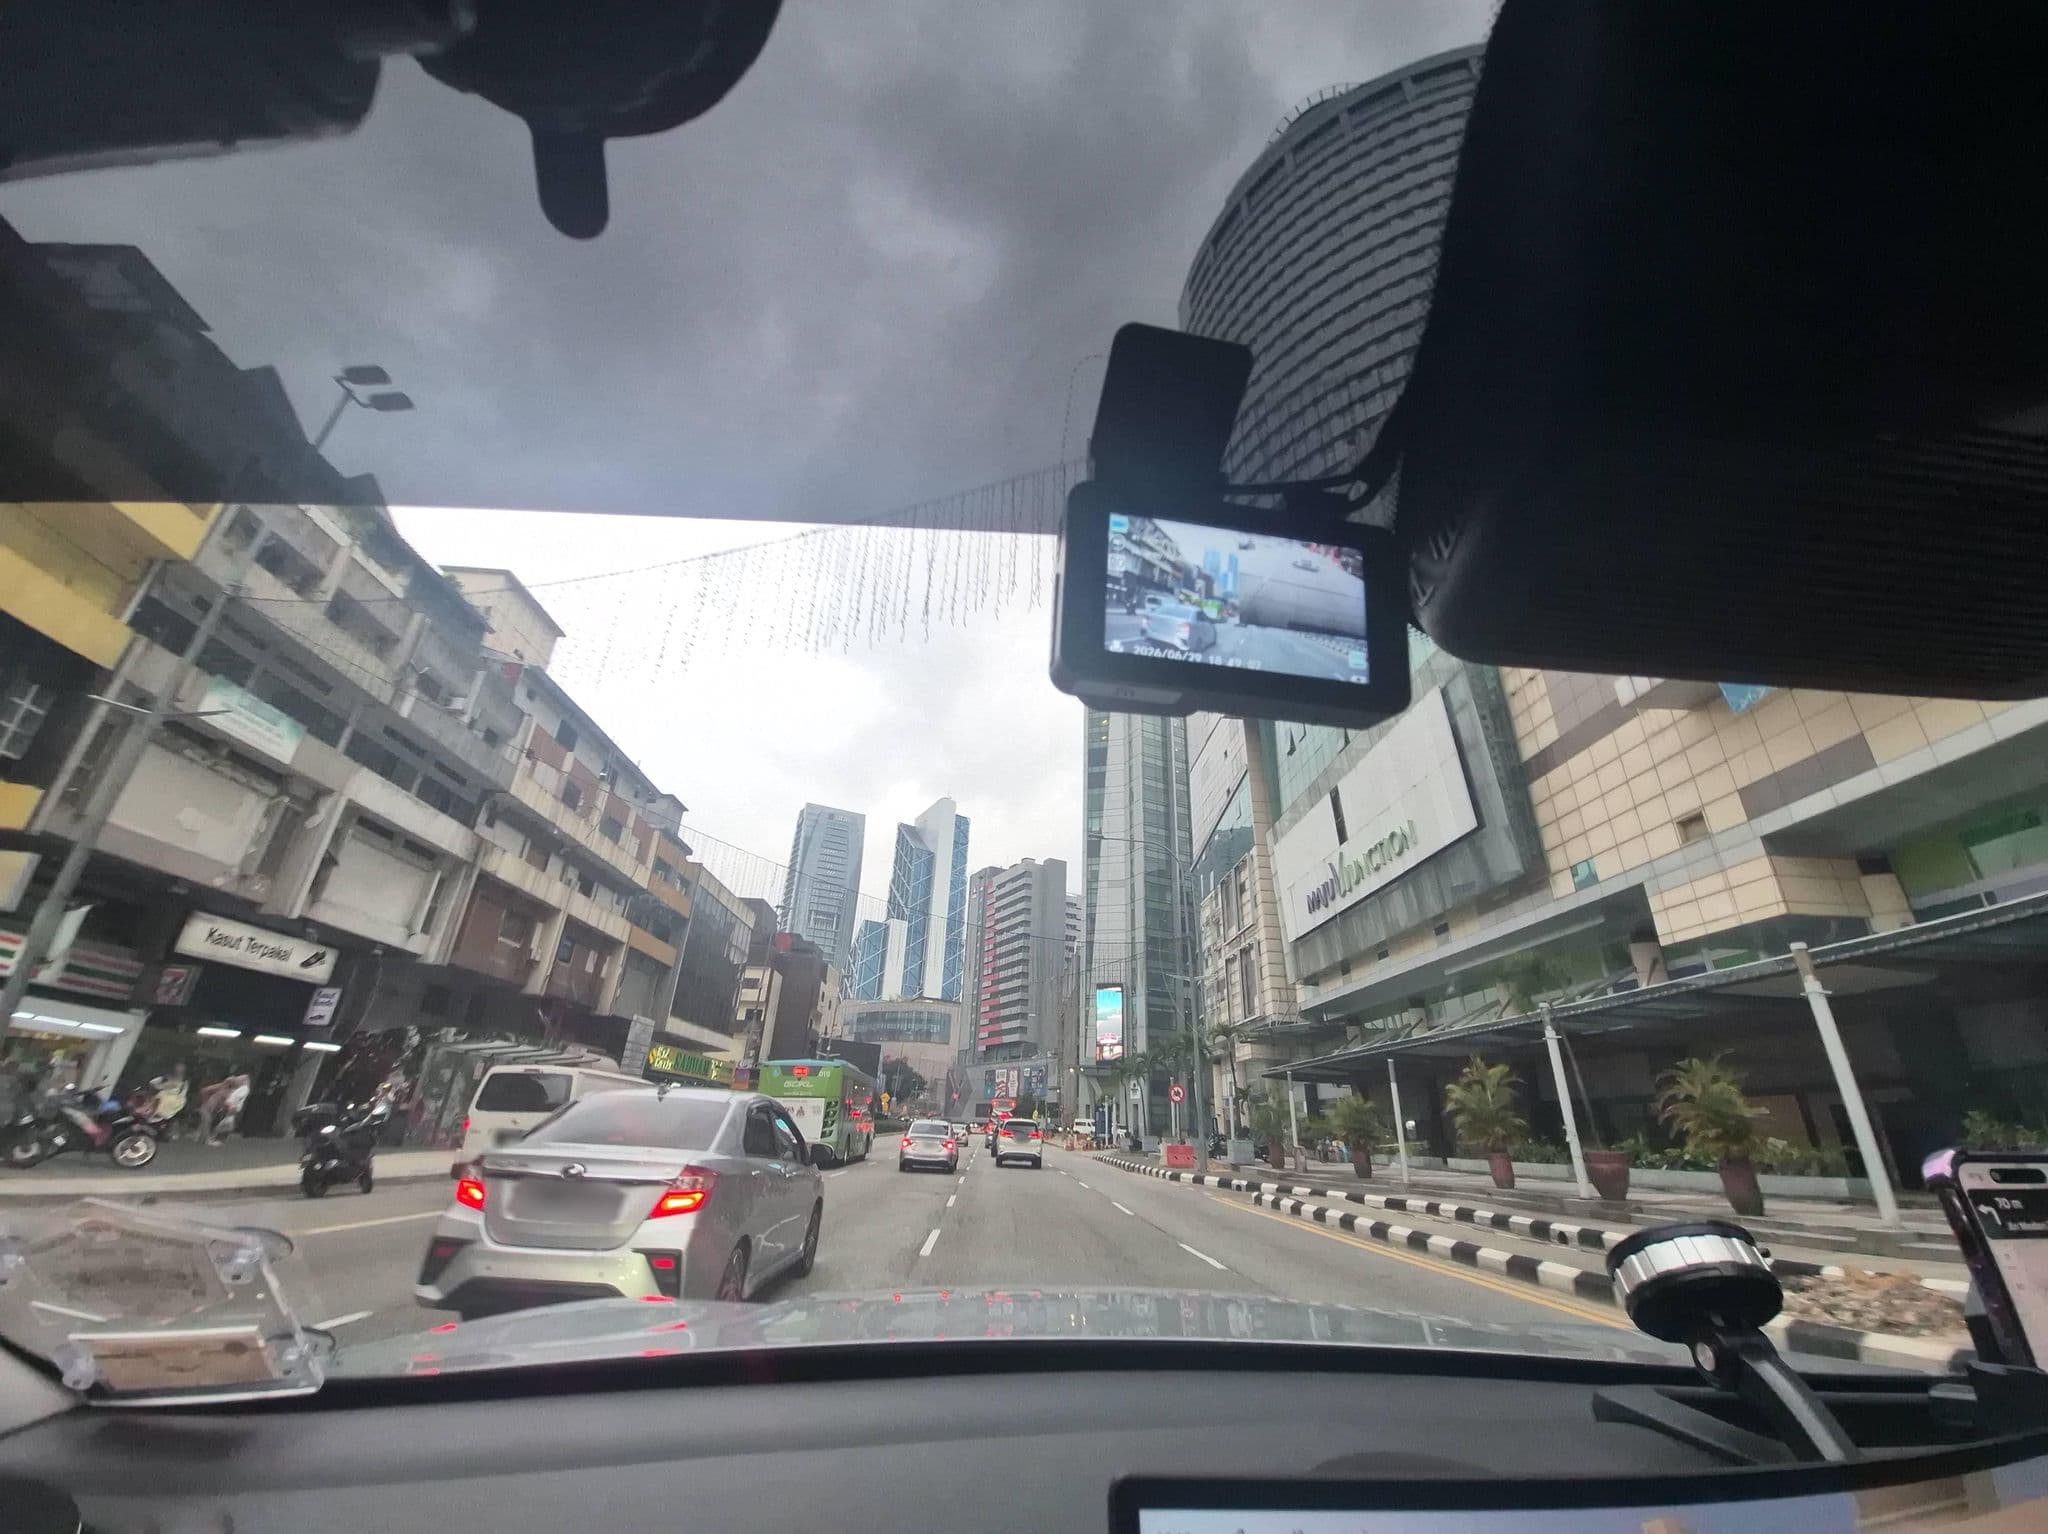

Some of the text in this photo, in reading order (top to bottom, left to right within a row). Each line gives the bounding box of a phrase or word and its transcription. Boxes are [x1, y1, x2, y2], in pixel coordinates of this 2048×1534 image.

[1306, 878, 1336, 914] MAJU
[205, 927, 244, 951] Kasut
[1994, 1197, 2011, 1210] 70
